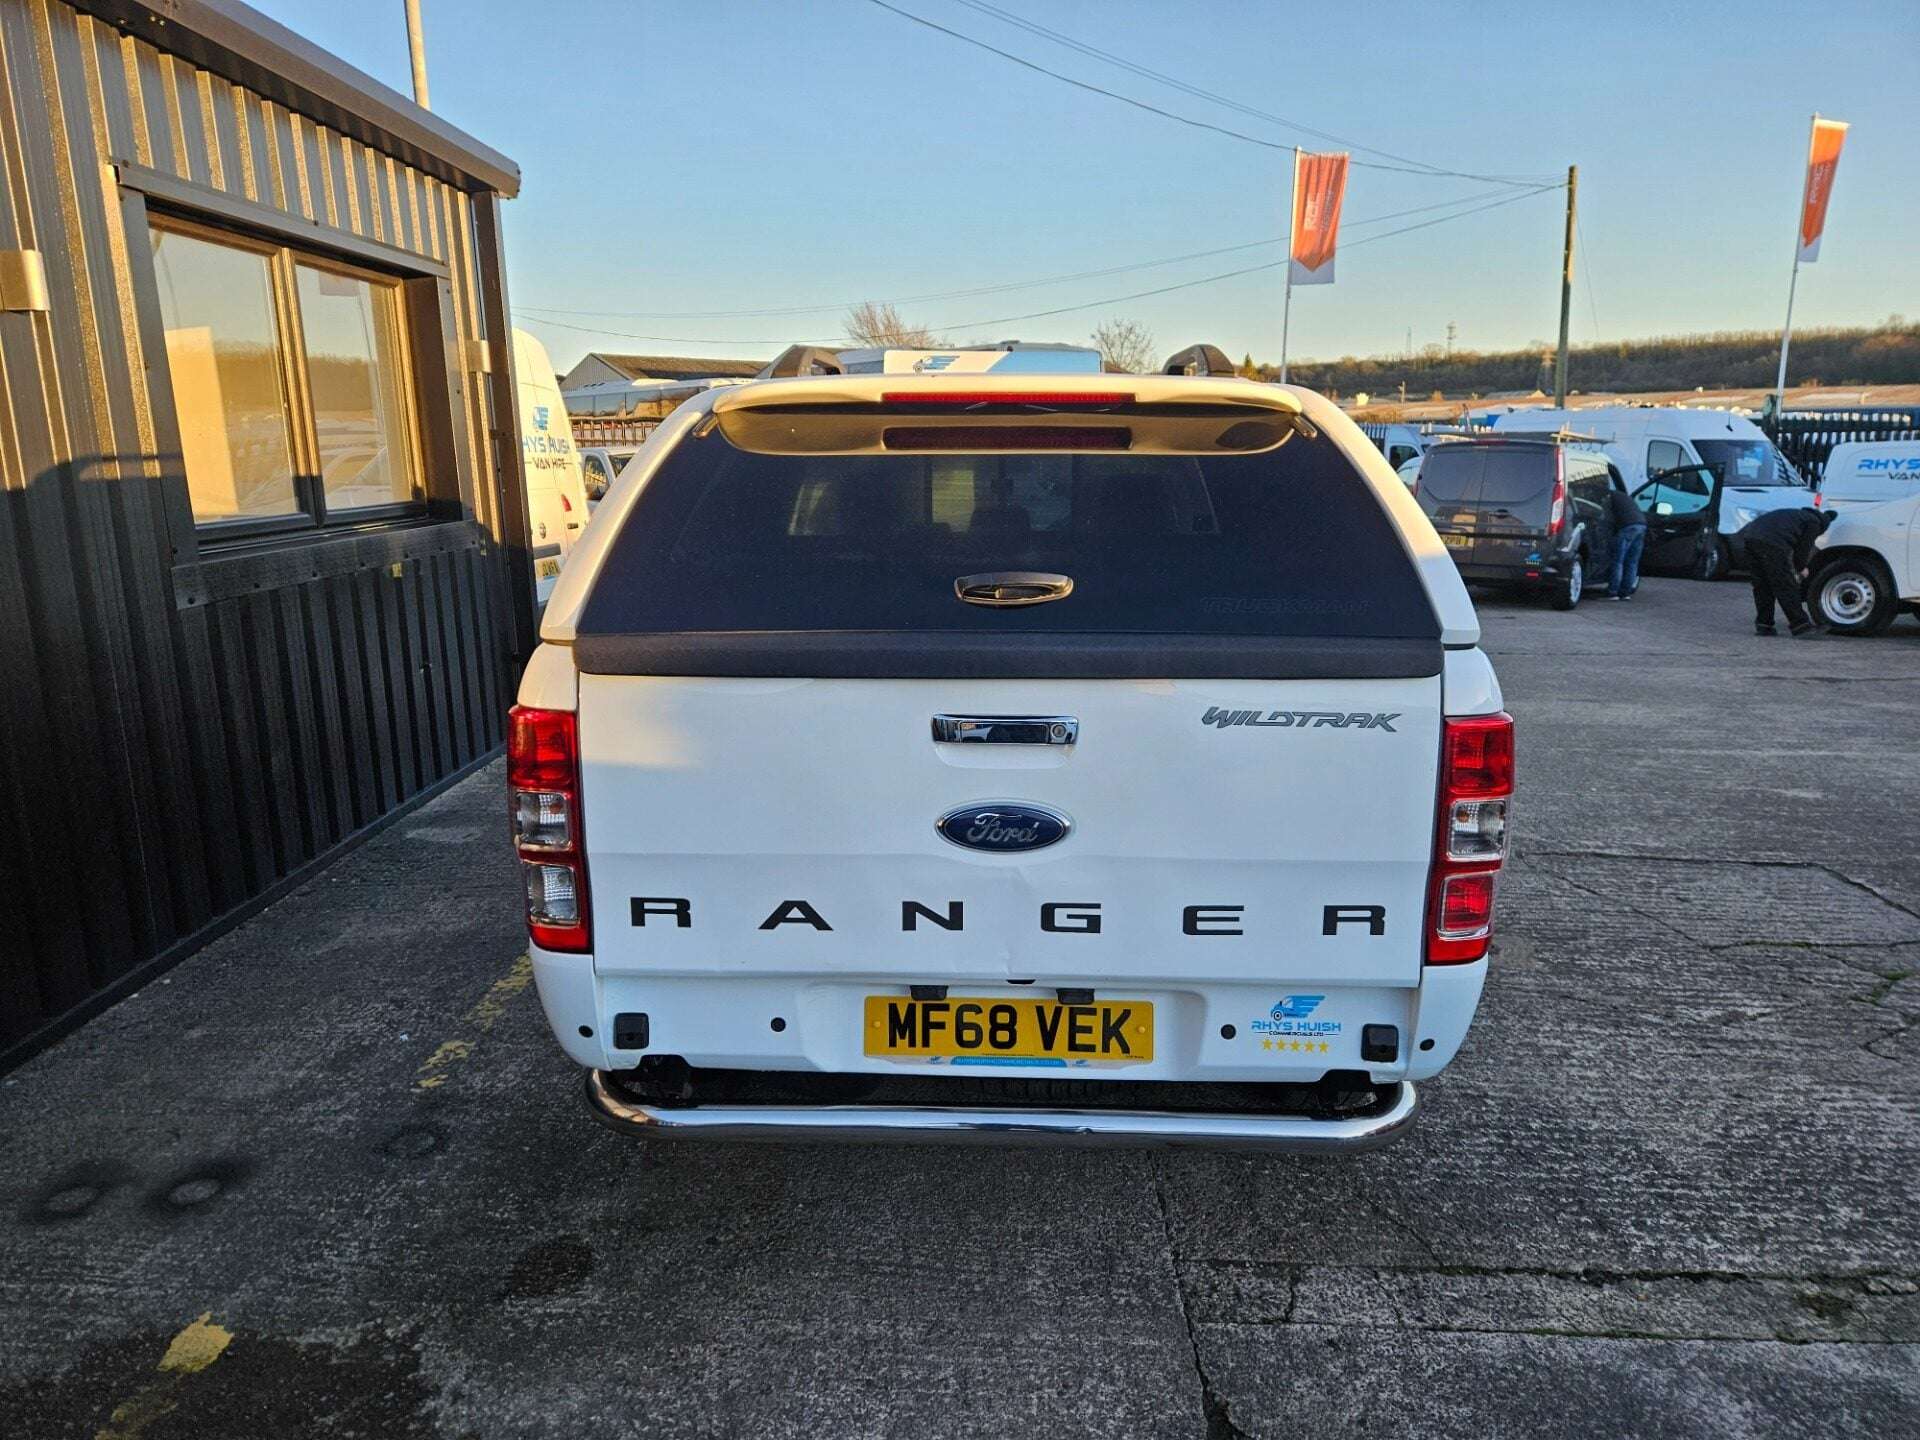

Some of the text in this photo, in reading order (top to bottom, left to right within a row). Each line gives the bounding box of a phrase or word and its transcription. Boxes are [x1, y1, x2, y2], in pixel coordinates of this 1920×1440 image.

[1857, 458, 1920, 470] RHYS
[1888, 471, 1920, 481] VAN
[1201, 706, 1402, 733] WILDTRAK
[967, 812, 1040, 842] Ford
[630, 896, 1387, 938] RANGER
[888, 1002, 1132, 1054] MF68 VEK
[1251, 1020, 1342, 1032] RHYS HUISH
